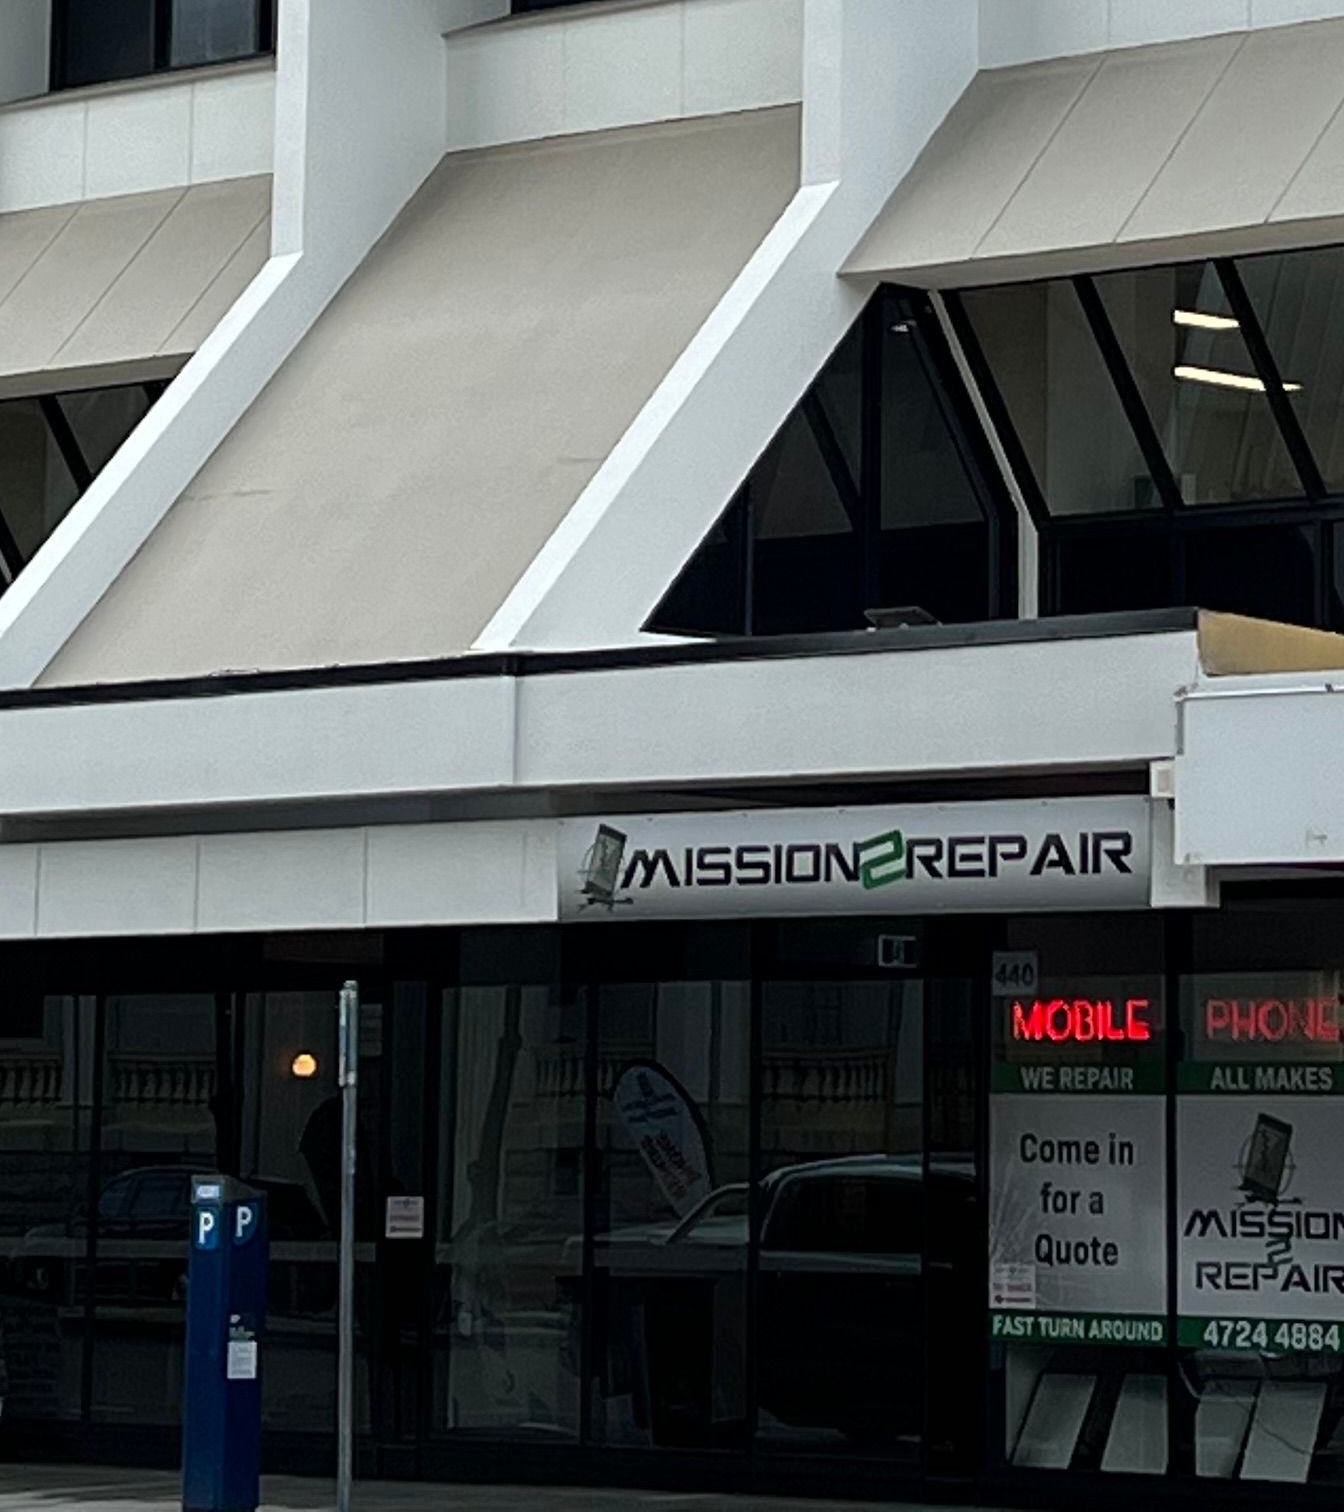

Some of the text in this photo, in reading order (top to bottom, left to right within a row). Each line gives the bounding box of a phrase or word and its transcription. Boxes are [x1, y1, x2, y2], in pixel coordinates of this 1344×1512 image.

[995, 963, 1034, 986] 440
[1013, 999, 1150, 1040] MOBILE
[1205, 999, 1340, 1040] PHONE
[1020, 1067, 1133, 1089] WE REPAIR
[1211, 1067, 1332, 1090] ALL MAKES
[1020, 1133, 1133, 1165] Come in
[1040, 1182, 1104, 1214] for a
[199, 1212, 216, 1245] P
[235, 1205, 253, 1238] P
[1035, 1234, 1119, 1266] Quote
[992, 1314, 1163, 1341] FAST TURN AROUND
[1204, 1320, 1341, 1351] 4724 4884
